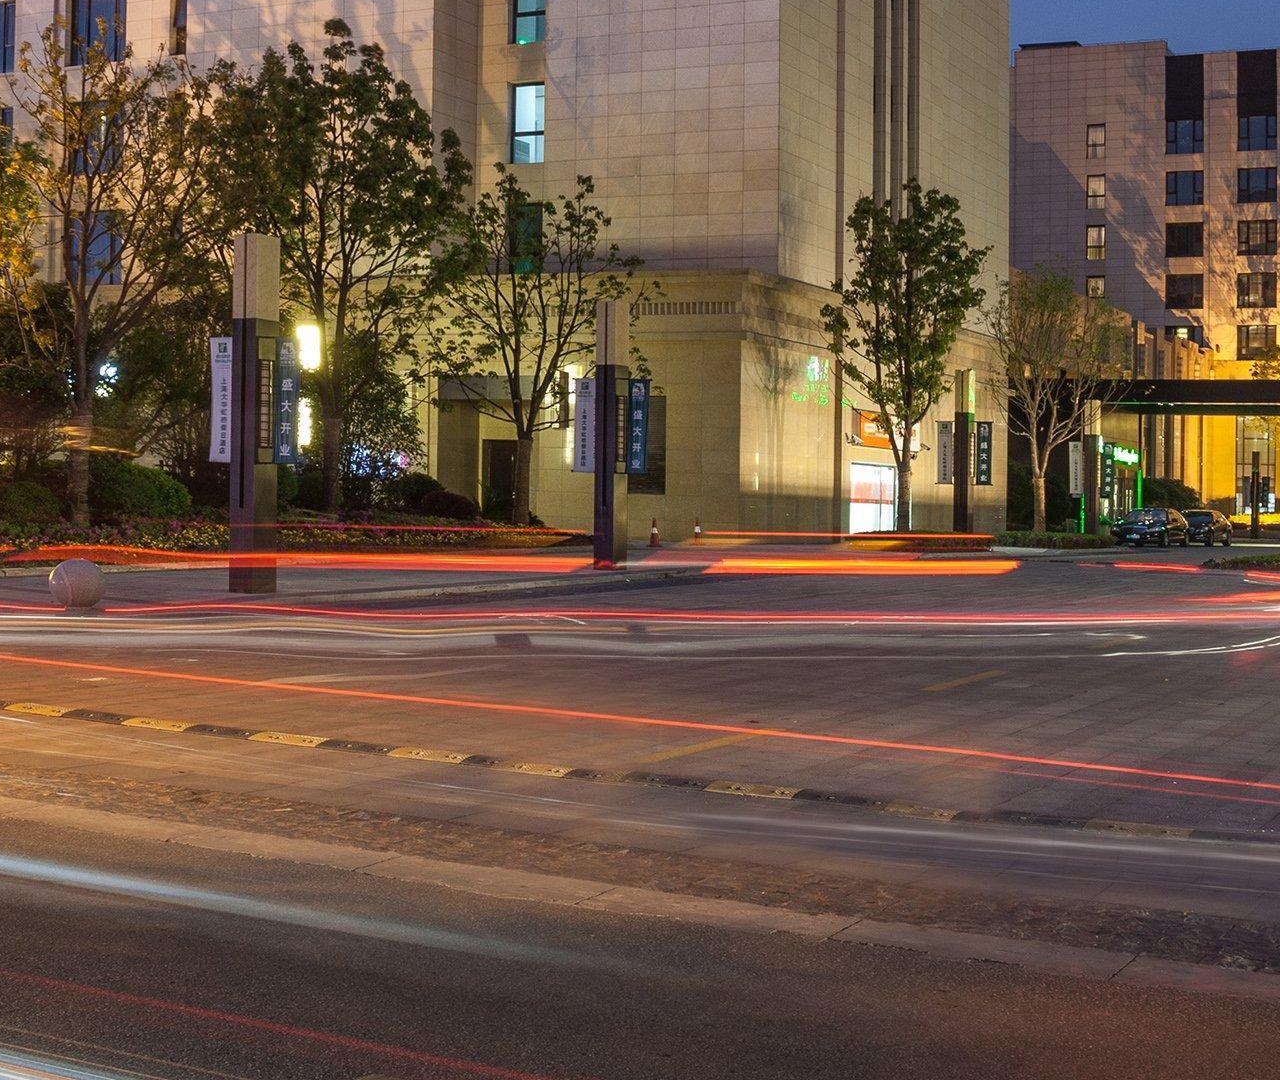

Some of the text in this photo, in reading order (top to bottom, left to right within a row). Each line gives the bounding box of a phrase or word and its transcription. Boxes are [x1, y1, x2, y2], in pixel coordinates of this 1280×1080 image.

[280, 378, 294, 456] 盛大开业
[631, 409, 643, 469] 盛大开业
